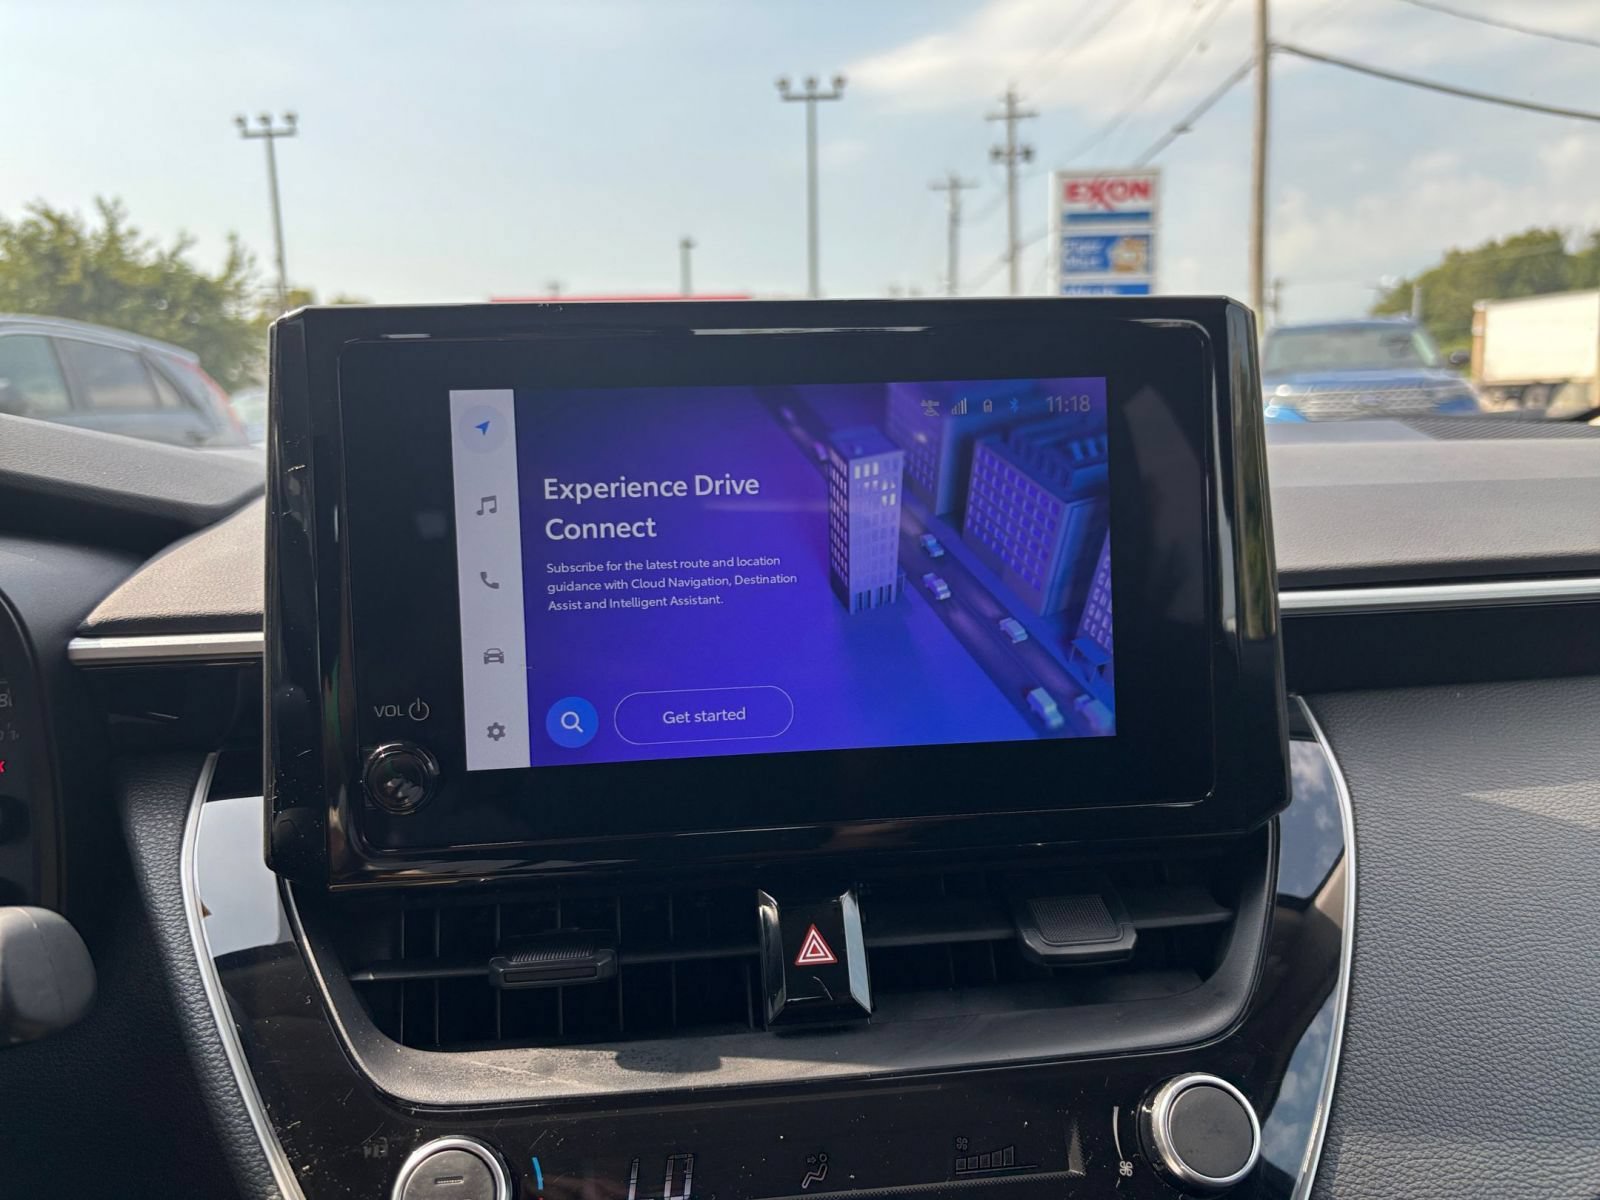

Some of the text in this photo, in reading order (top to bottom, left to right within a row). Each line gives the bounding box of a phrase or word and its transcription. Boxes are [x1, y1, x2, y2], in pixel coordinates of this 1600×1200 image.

[1046, 395, 1091, 412] 11:18
[543, 473, 760, 505] Experience Drive
[545, 517, 658, 541] Connect
[546, 556, 781, 574] Subscribe for the latest route and location
[546, 573, 798, 595] guidance with Cloud Navigation, Destination
[547, 594, 724, 611] Assist and Intelligent Assistant.
[373, 704, 405, 718] VOL
[662, 706, 746, 725] Get started
